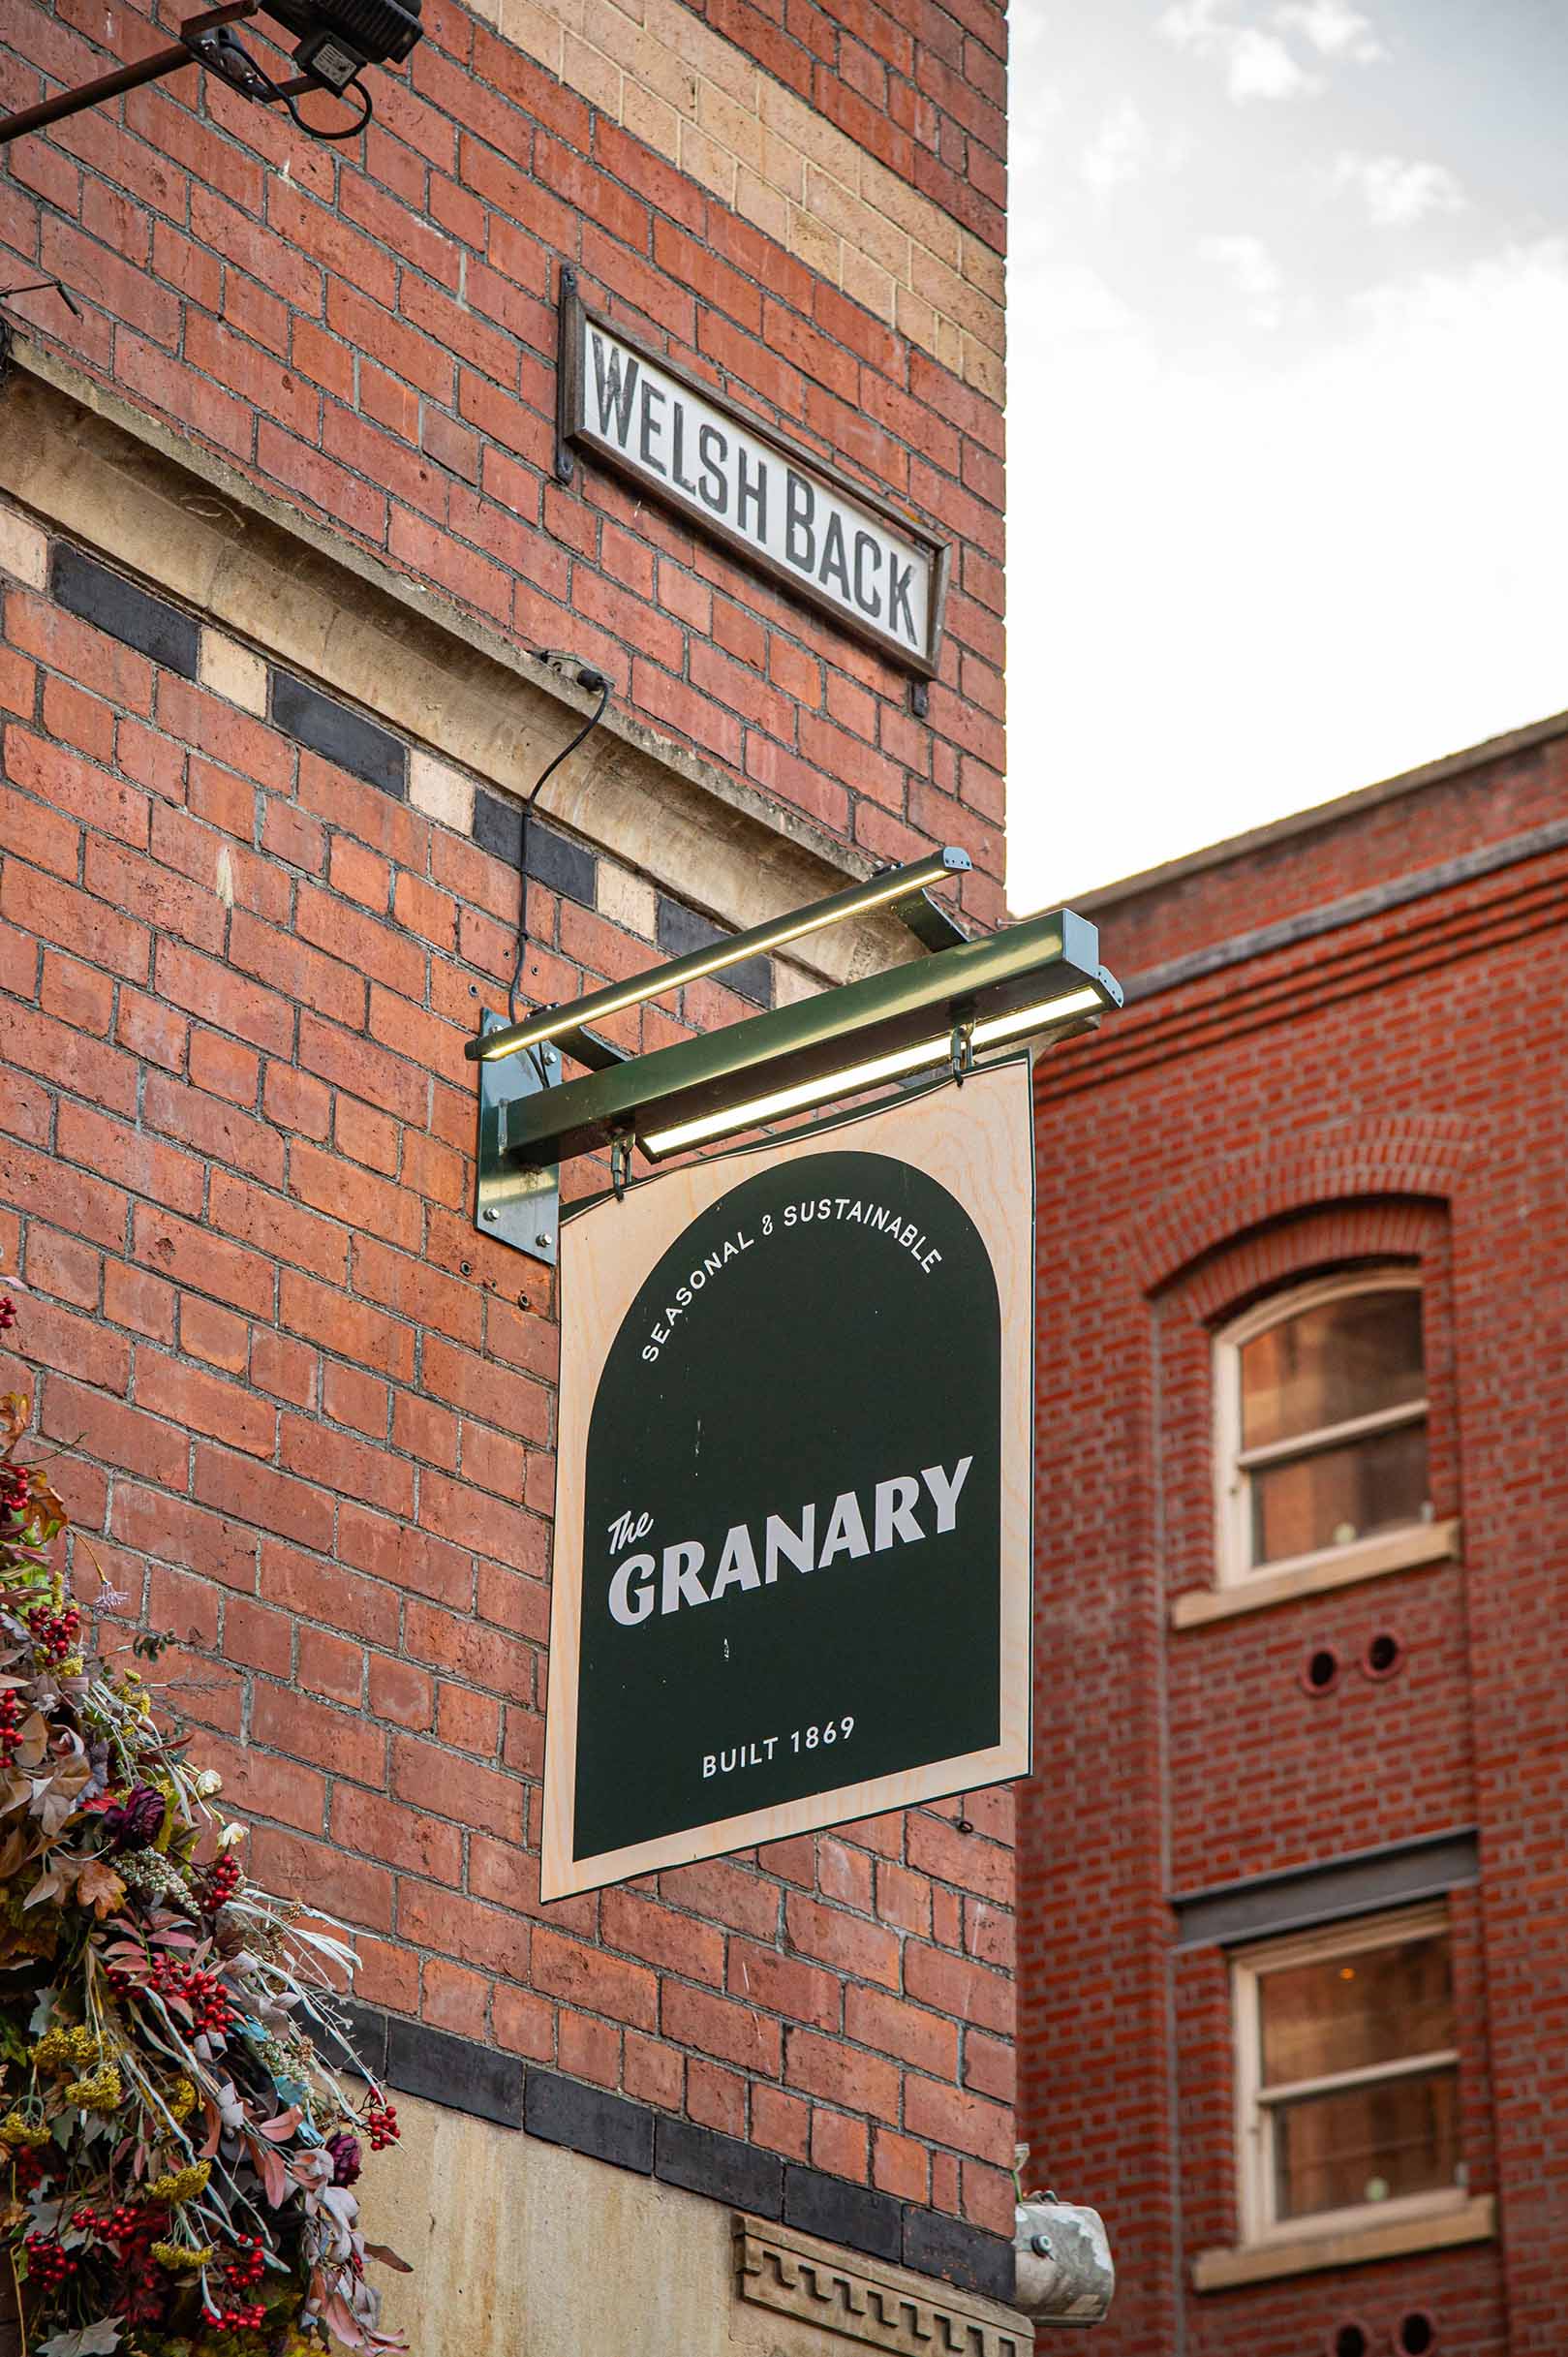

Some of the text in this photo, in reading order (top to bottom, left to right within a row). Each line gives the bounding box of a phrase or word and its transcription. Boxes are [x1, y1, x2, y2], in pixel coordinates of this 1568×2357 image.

[591, 332, 919, 647] WELSH BACK
[641, 1198, 943, 1362] SEASONAL & SUSTAINABLE
[607, 1510, 655, 1555] The
[608, 1455, 973, 1627] GRANARY
[702, 1716, 854, 1779] BUILT 1869
